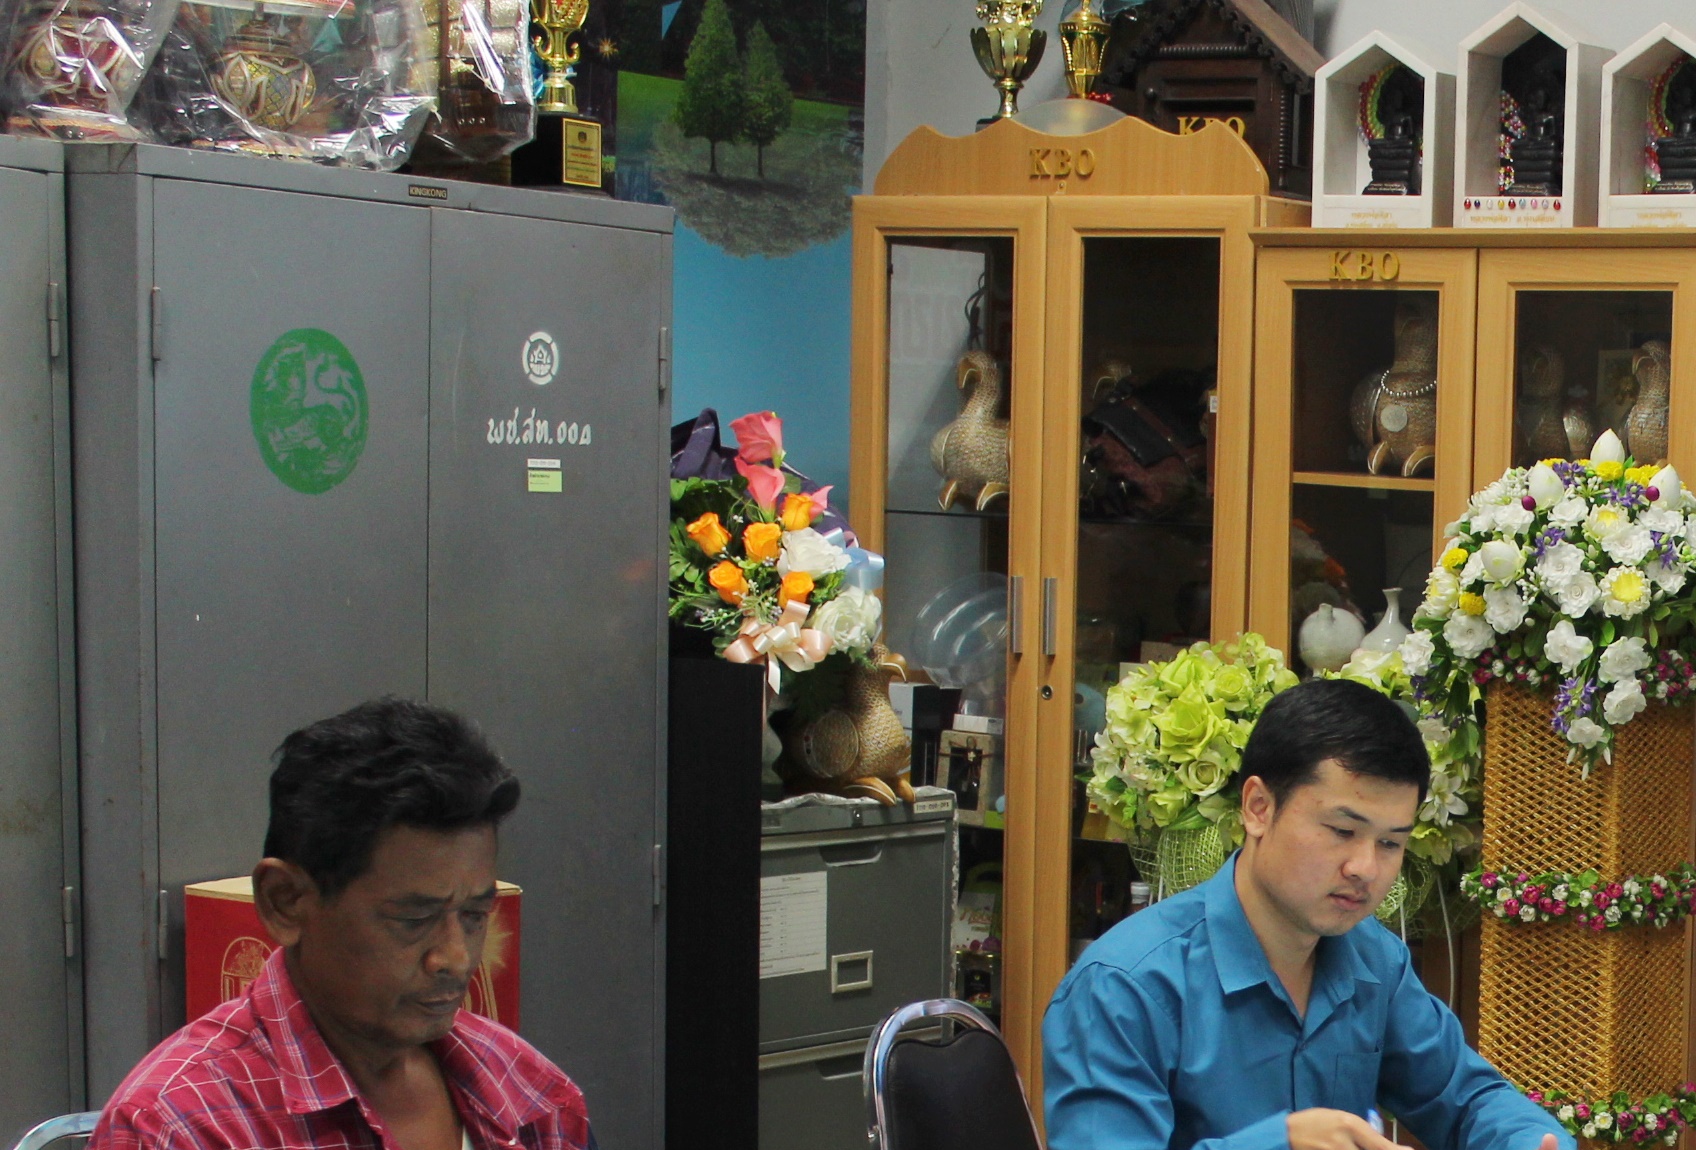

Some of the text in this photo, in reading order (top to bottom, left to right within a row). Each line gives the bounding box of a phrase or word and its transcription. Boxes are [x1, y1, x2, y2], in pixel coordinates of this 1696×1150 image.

[1177, 116, 1246, 140] KO
[1029, 148, 1096, 178] KBO
[1328, 250, 1400, 280] KBO
